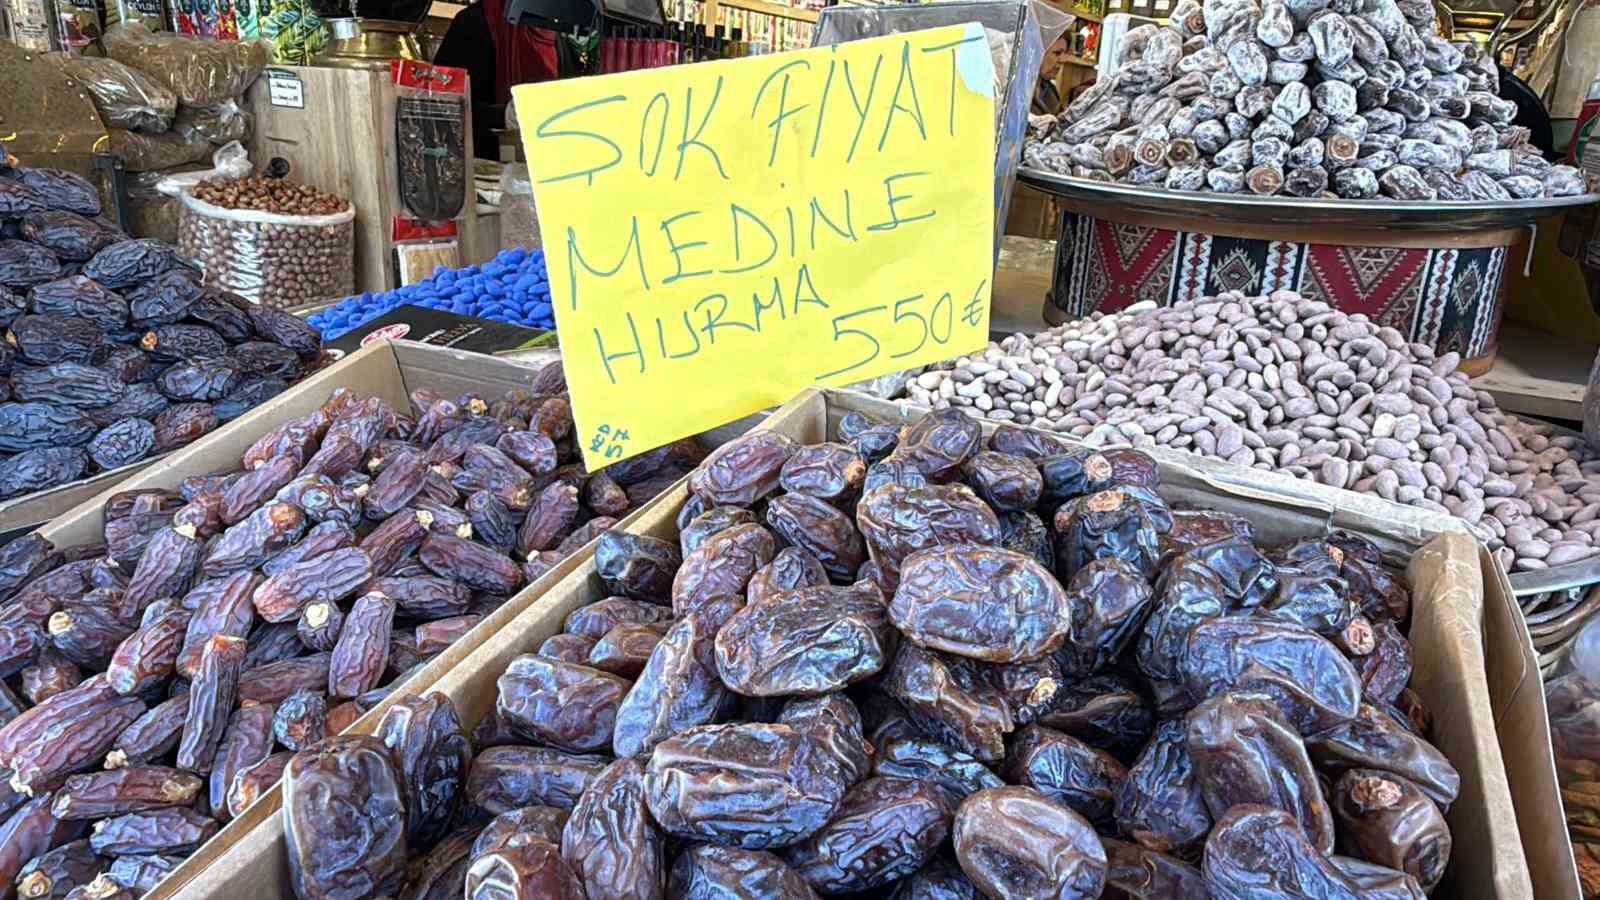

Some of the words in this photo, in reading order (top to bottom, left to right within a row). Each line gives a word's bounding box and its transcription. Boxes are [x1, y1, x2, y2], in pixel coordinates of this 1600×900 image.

[536, 76, 730, 187] ŞOK
[752, 36, 985, 168] FİYAT
[567, 172, 937, 311] MEDİNE
[593, 263, 830, 385] HURMA
